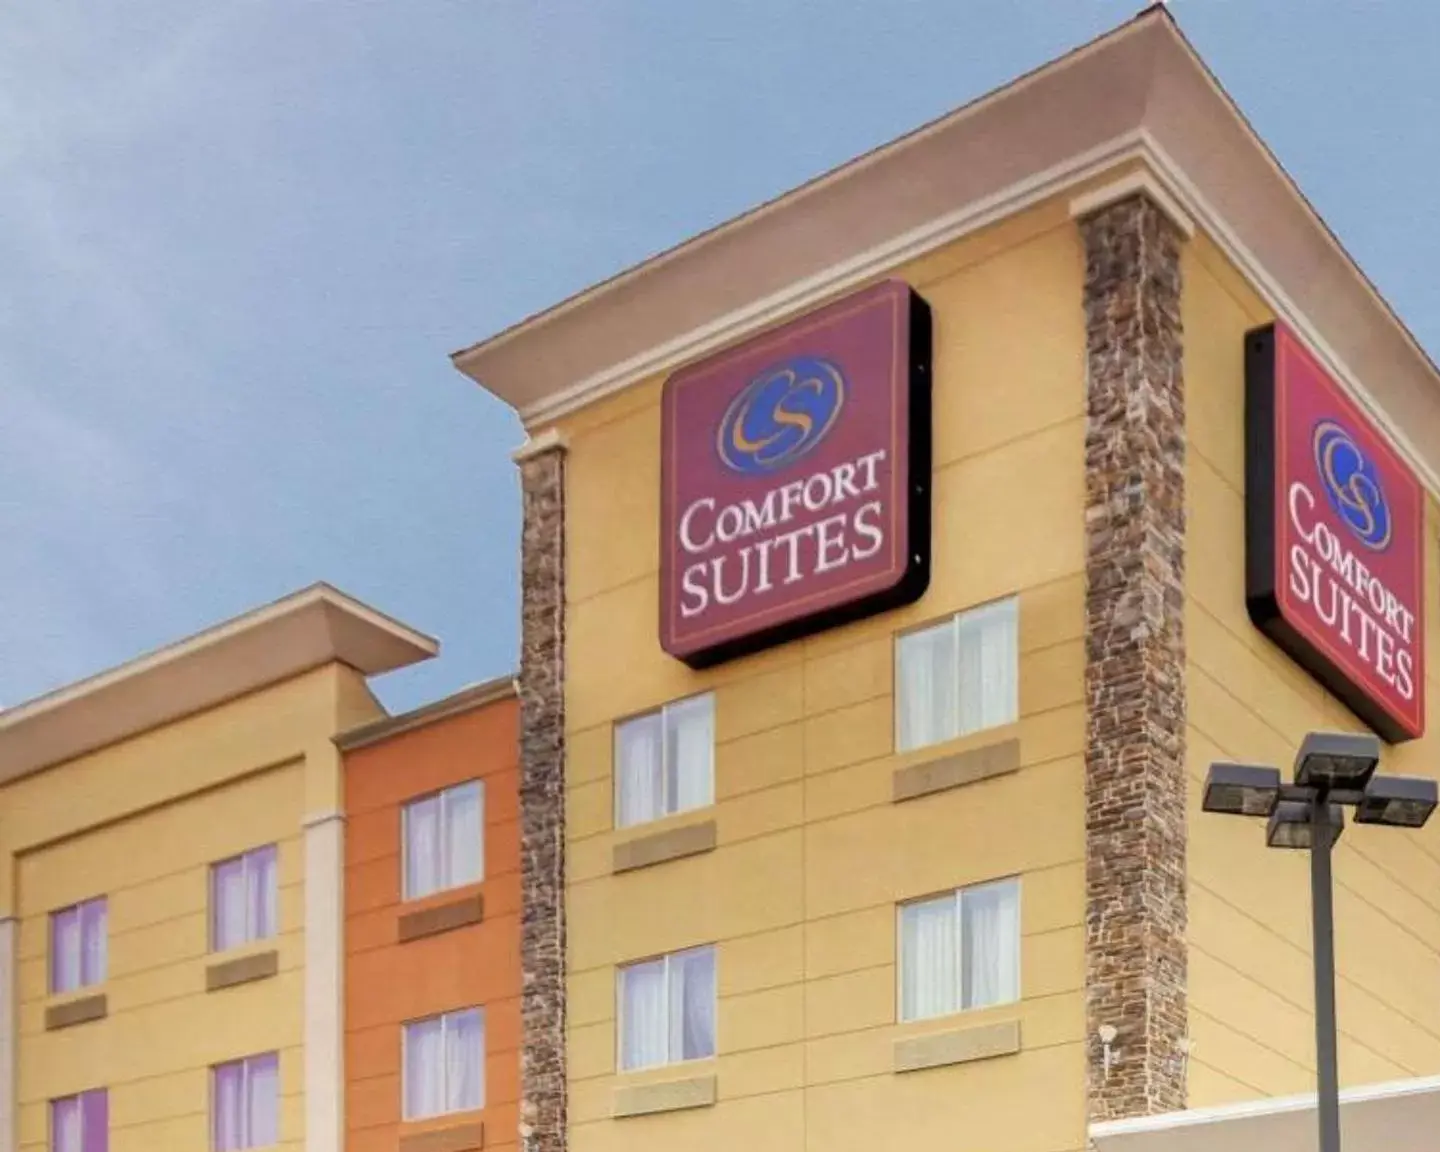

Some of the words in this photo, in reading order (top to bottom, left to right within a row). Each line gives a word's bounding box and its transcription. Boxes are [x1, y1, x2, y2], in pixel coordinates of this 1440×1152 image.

[679, 450, 886, 553] COMFORT
[680, 501, 884, 618] SUITES
[1289, 482, 1415, 644] COMFORT
[1289, 544, 1414, 700] SUITES
